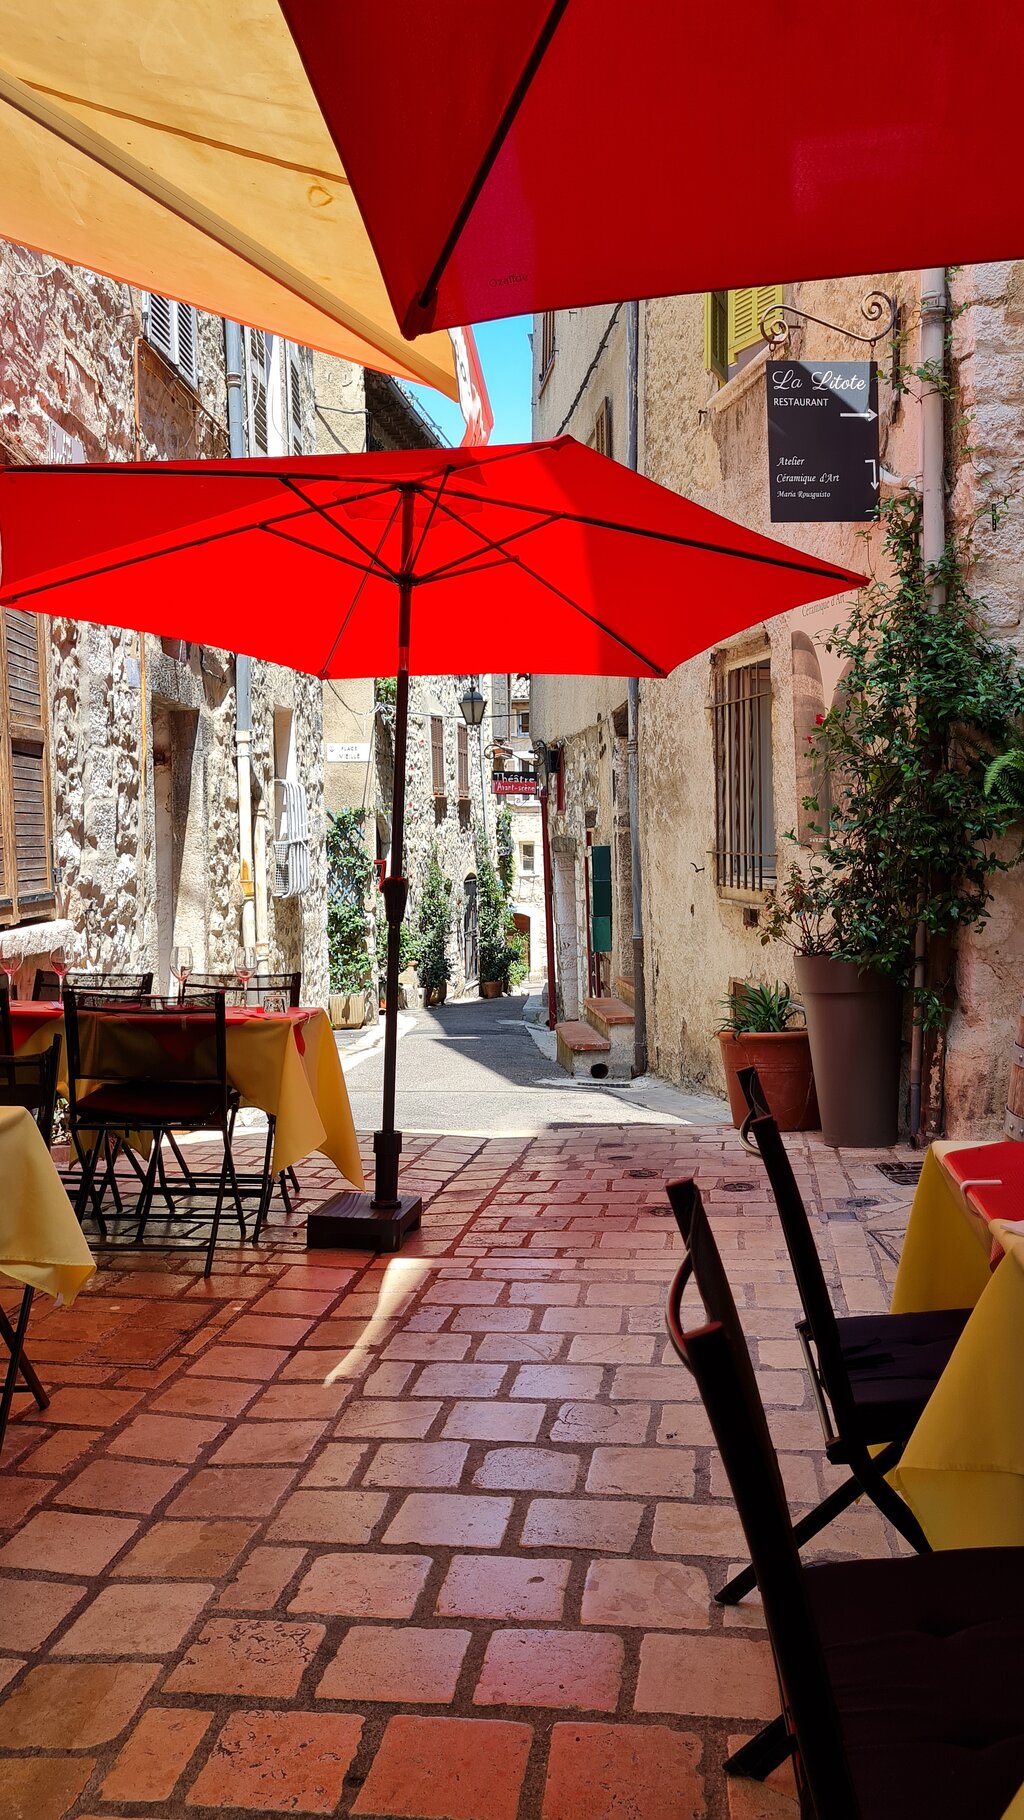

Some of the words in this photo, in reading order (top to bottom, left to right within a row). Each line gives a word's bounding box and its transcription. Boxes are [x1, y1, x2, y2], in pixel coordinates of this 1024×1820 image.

[772, 369, 803, 390] La
[811, 370, 867, 391] Litote
[773, 397, 829, 407] RESTAURANT
[776, 455, 805, 467] Atelier
[776, 473, 817, 485] Céramique
[819, 472, 840, 484] d'Art
[776, 490, 797, 498] Maria
[493, 772, 536, 784] Théâtre
